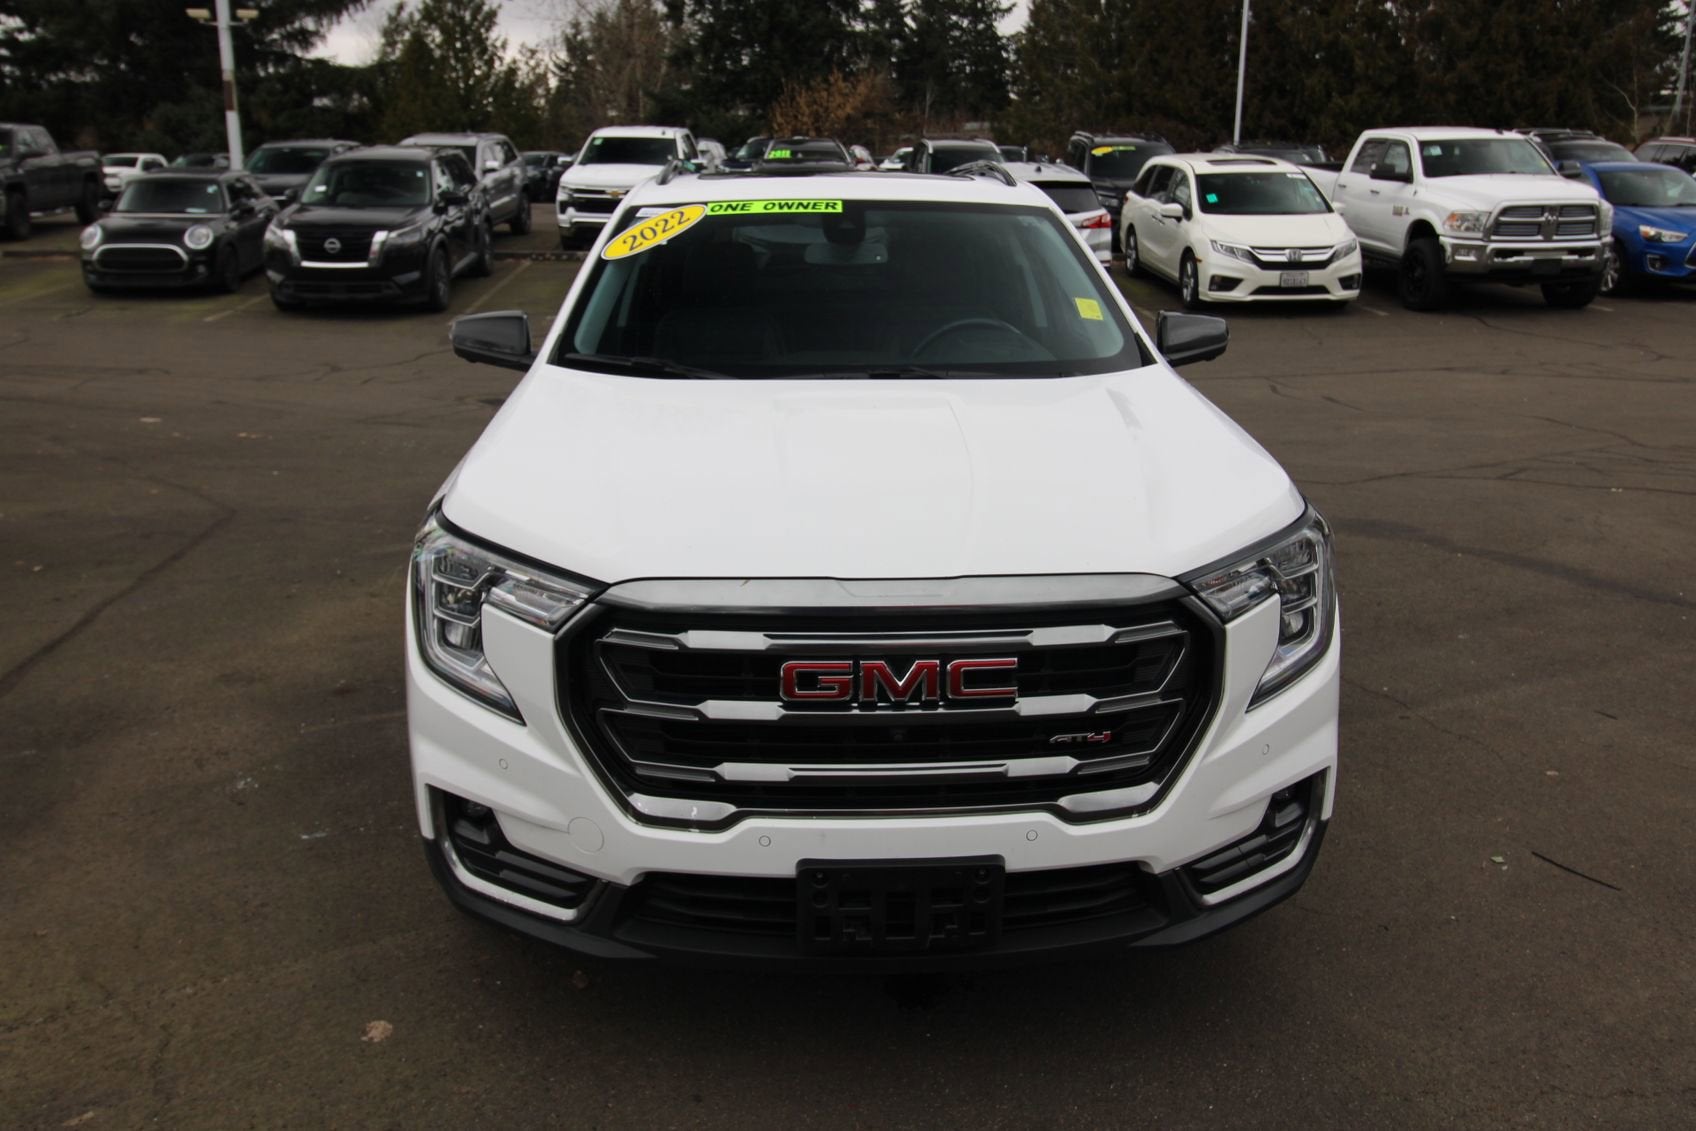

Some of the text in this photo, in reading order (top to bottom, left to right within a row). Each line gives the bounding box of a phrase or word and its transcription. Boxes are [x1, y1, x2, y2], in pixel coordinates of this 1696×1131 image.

[710, 201, 838, 213] ONE OWNER
[623, 210, 691, 251] 2022
[780, 658, 1018, 702] GMC
